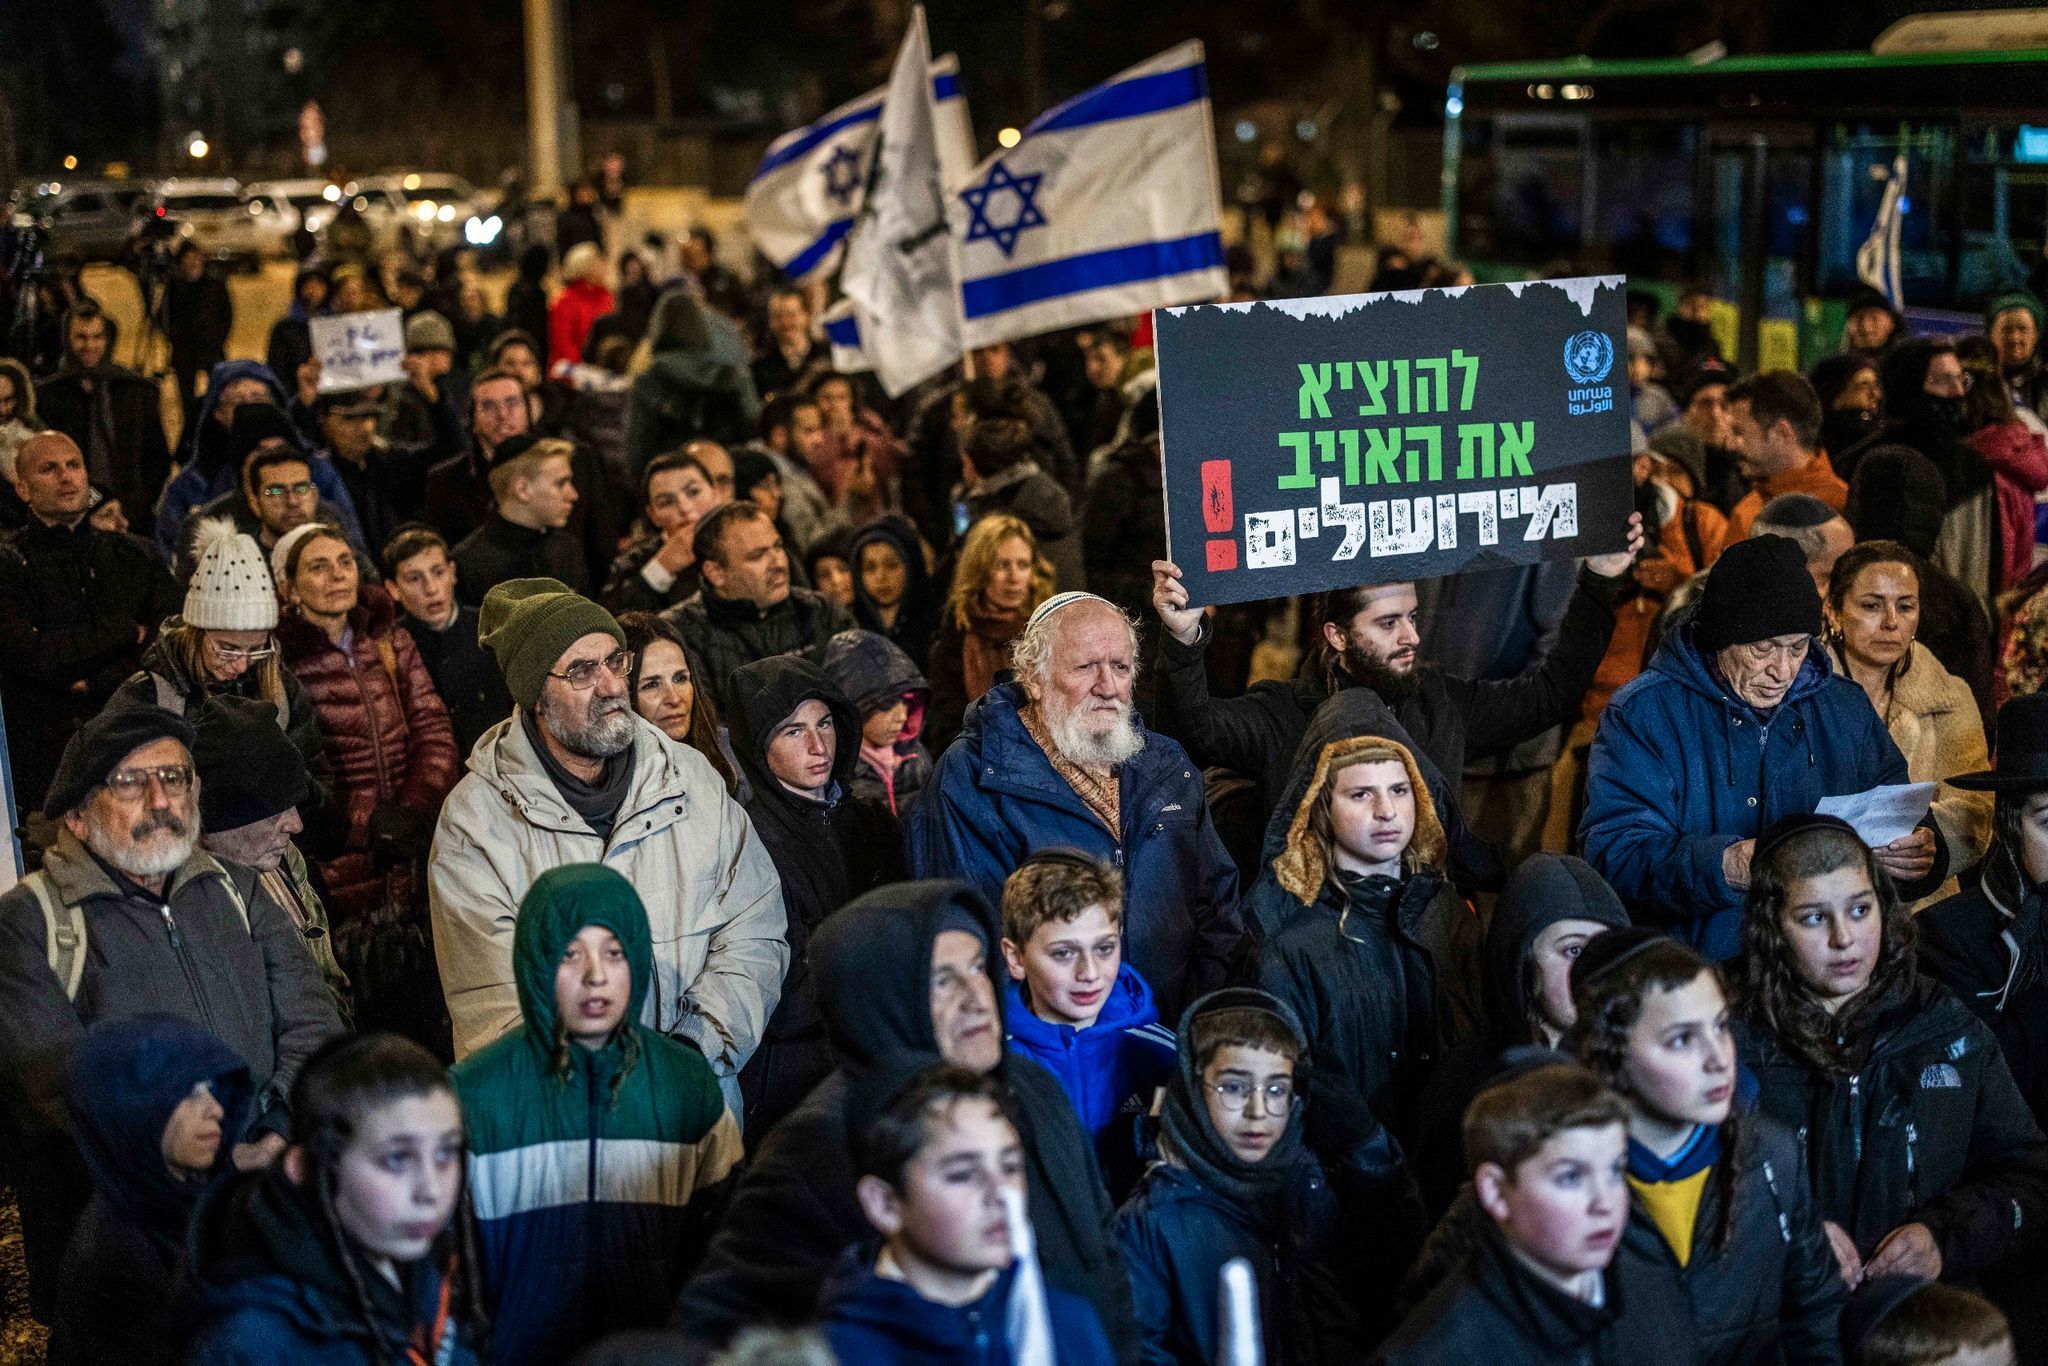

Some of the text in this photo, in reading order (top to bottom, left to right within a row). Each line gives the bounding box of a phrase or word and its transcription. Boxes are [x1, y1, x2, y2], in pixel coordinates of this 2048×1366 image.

[1298, 349, 1479, 420] להוציא
[1568, 386, 1613, 401] unrwa
[1278, 420, 1535, 489] את האויב
